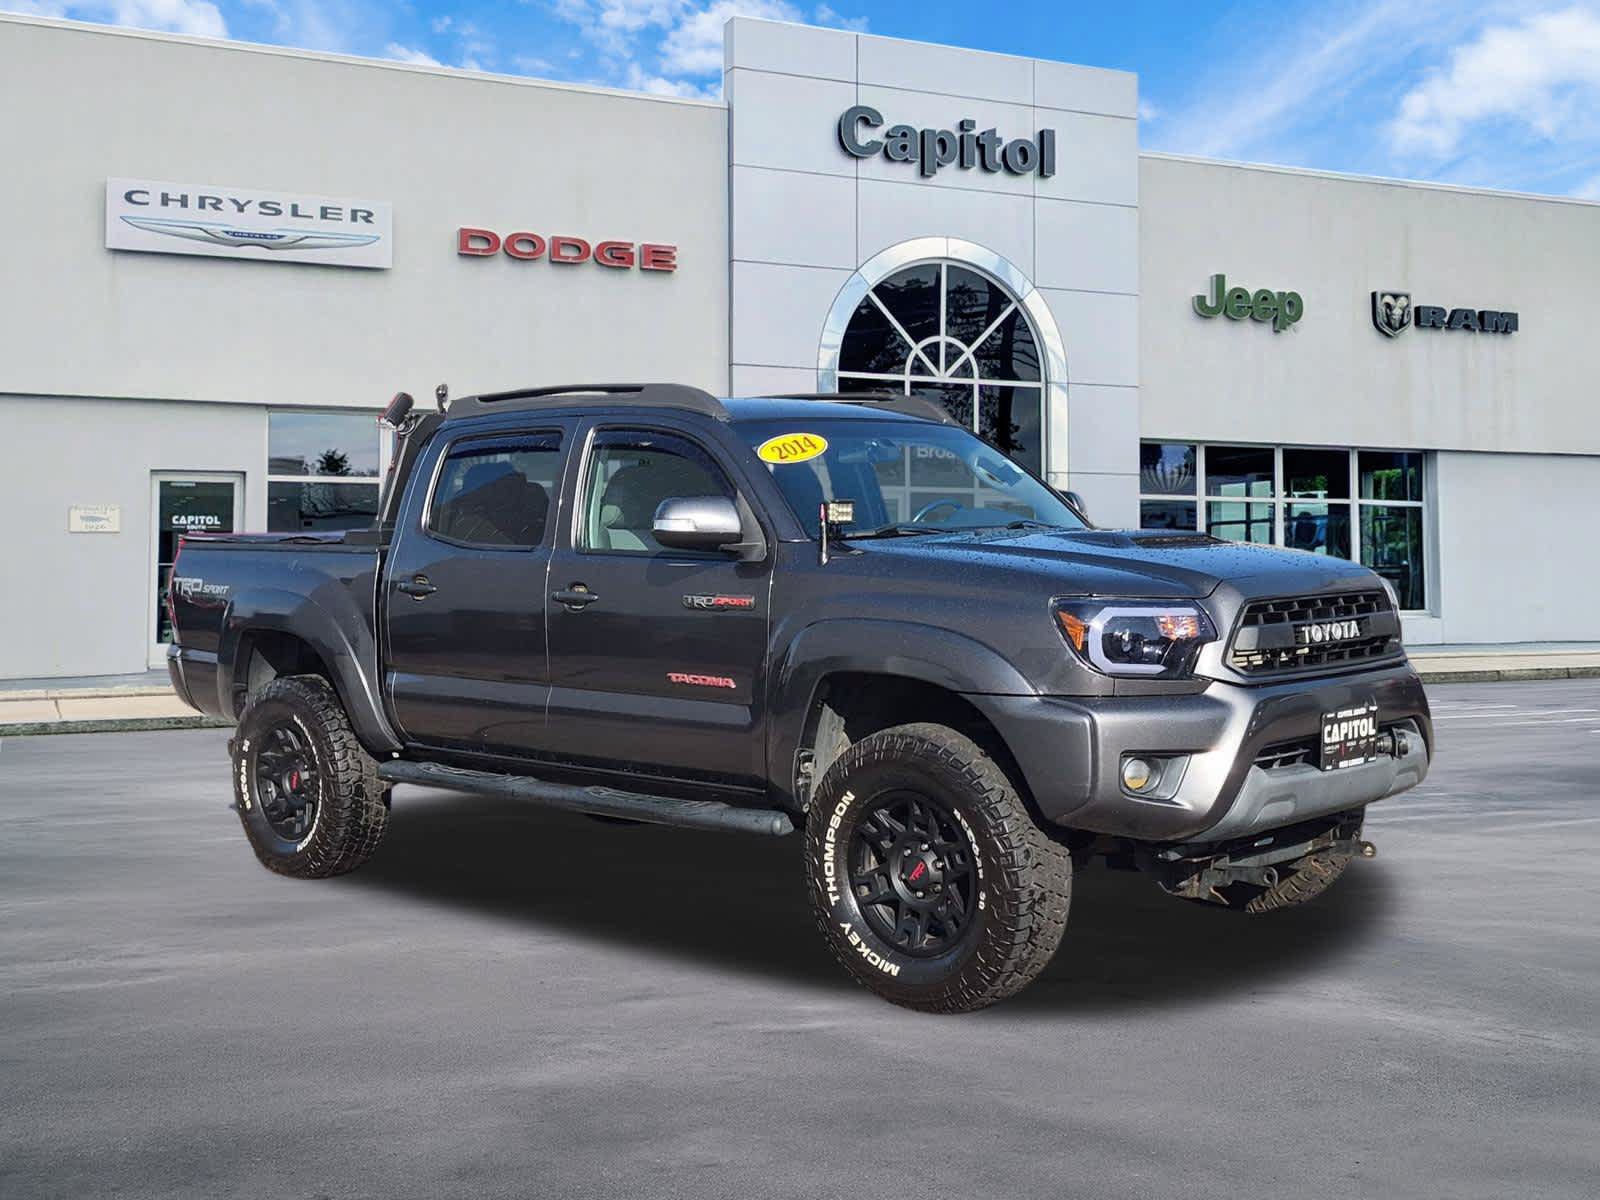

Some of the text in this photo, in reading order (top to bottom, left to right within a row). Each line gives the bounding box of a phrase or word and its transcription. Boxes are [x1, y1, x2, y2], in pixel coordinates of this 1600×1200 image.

[838, 105, 1056, 178] Capitol
[124, 189, 375, 225] CHRYSLER
[457, 227, 678, 273] DODGE
[1191, 273, 1304, 333] Jeep
[1414, 304, 1519, 334] RAM
[771, 436, 818, 460] 2014
[171, 515, 222, 525] CAPITOL
[1301, 620, 1361, 644] TOYOTA
[666, 672, 737, 689] TACOMA
[1323, 717, 1377, 744] CAPITOL
[823, 791, 901, 977] MICKEY THOMPSON
